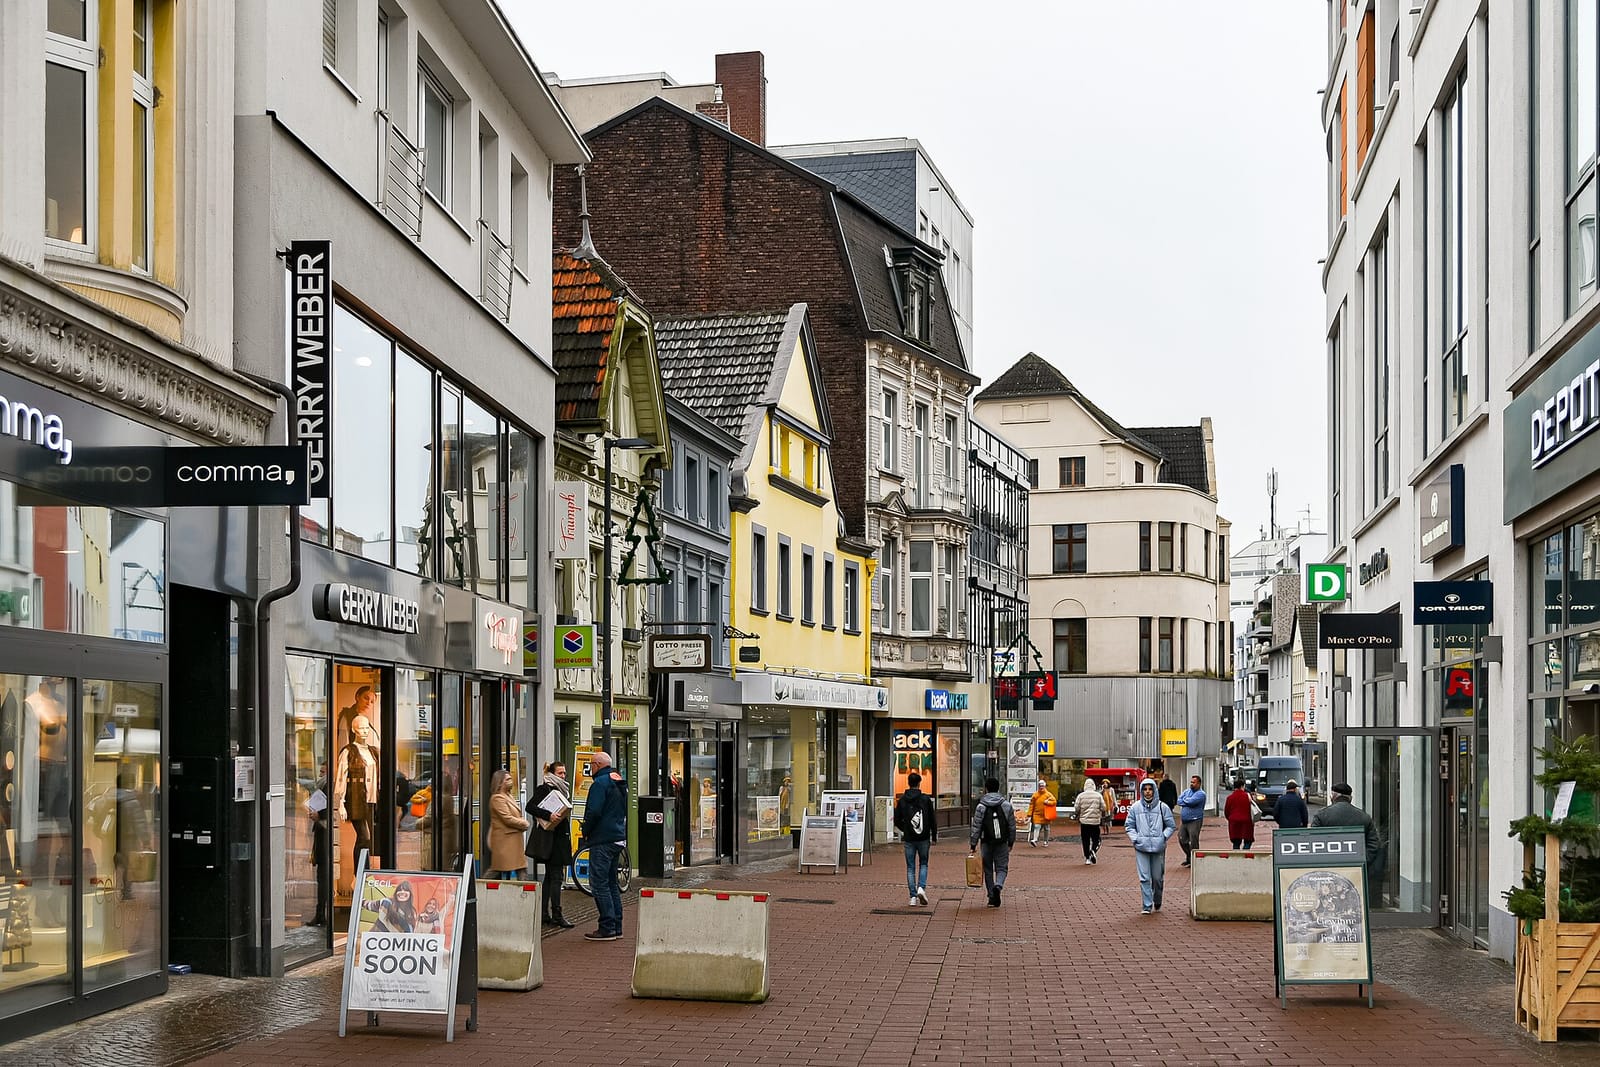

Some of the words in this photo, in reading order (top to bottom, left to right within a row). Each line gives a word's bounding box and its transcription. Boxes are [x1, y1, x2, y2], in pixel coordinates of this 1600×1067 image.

[297, 252, 324, 367] WEBER
[1532, 359, 1599, 460] DEPOT
[297, 374, 324, 483] GERRY
[177, 465, 295, 485] comma,
[560, 493, 581, 551] Triumph
[1314, 571, 1341, 597] D
[340, 583, 381, 626] GERRY
[382, 593, 419, 634] WEBER
[1327, 636, 1355, 644] Marc
[1357, 636, 1392, 644] O'Polo
[616, 708, 631, 721] LOTTO
[893, 731, 931, 748] ack
[1281, 841, 1357, 854] DEPOT
[367, 879, 392, 888] CECIL
[366, 937, 438, 952] COMING
[364, 954, 437, 975] SOON
